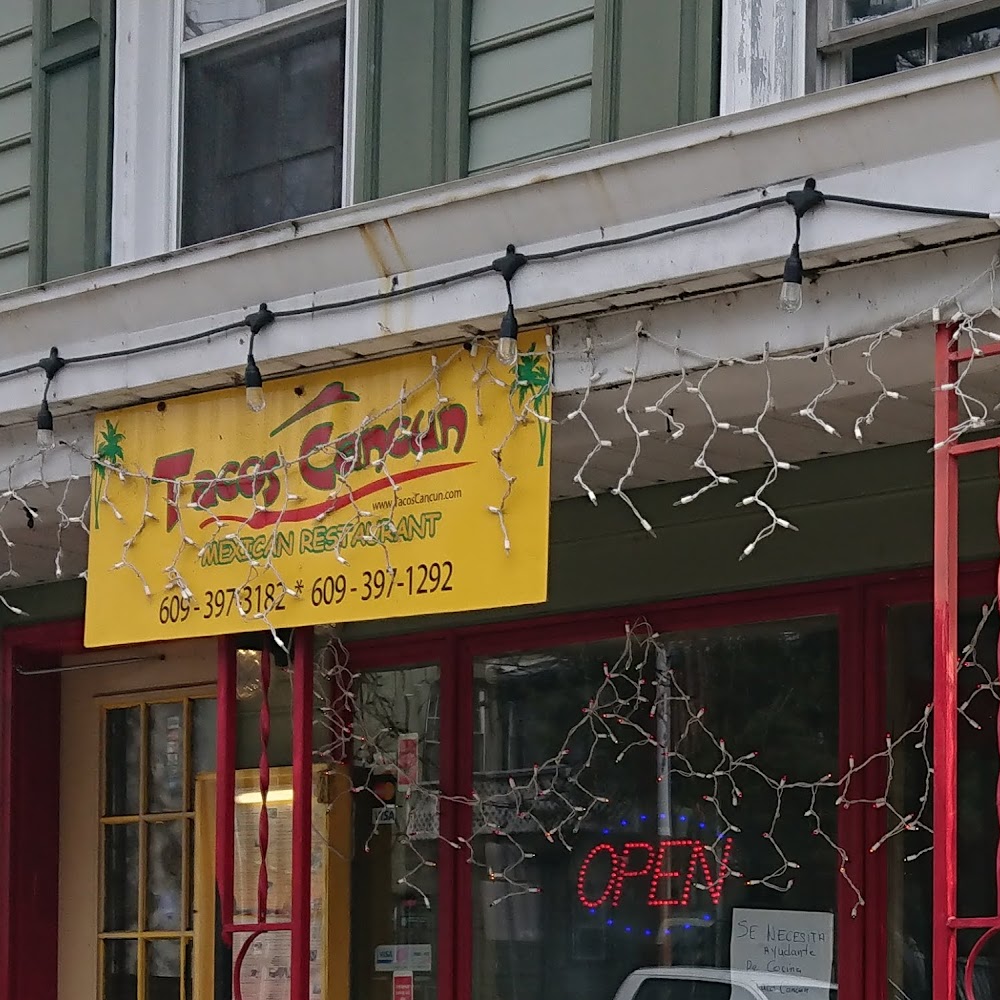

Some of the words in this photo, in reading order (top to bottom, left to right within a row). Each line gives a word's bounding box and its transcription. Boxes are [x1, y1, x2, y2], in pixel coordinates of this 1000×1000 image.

[151, 449, 281, 533] Tacos
[300, 404, 467, 490] Cancun
[371, 489, 462, 511] wwwTacosCancun.com
[201, 530, 295, 567] MEXICAN
[300, 511, 443, 554] RESTAURANT
[577, 837, 733, 908] OPEN
[737, 920, 759, 940] SE
[766, 923, 825, 943] NECESITA
